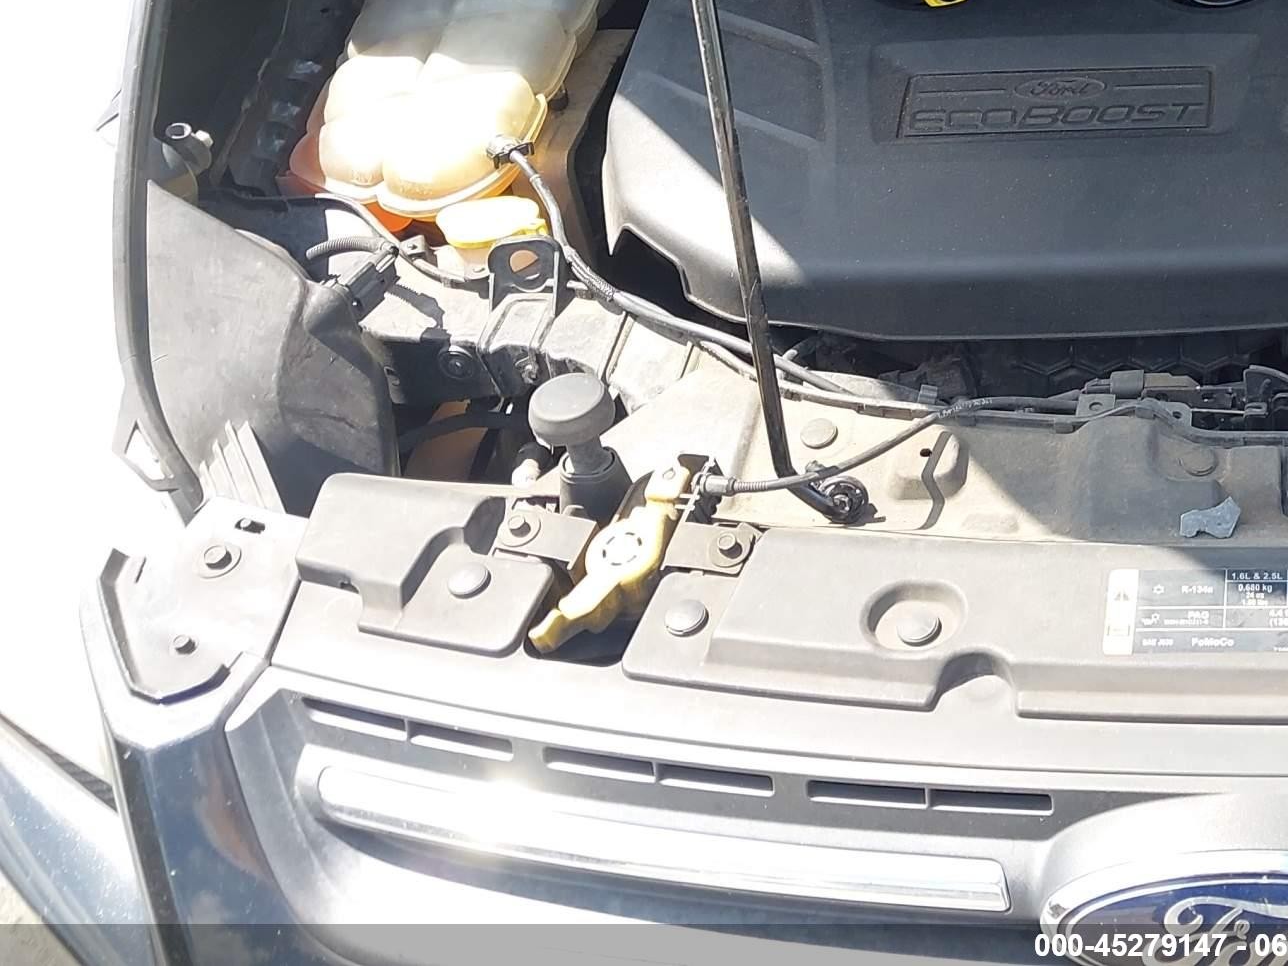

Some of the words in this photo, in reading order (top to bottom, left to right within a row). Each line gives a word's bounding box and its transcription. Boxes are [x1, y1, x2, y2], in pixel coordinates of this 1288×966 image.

[1028, 79, 1091, 96] Ford
[909, 102, 1205, 133] ECOBOOST
[1253, 572, 1261, 580] &
[1263, 572, 1283, 580] 2.5L
[1238, 583, 1260, 592] 0.680
[1262, 583, 1273, 593] kg
[1190, 637, 1235, 647] FoMoCo
